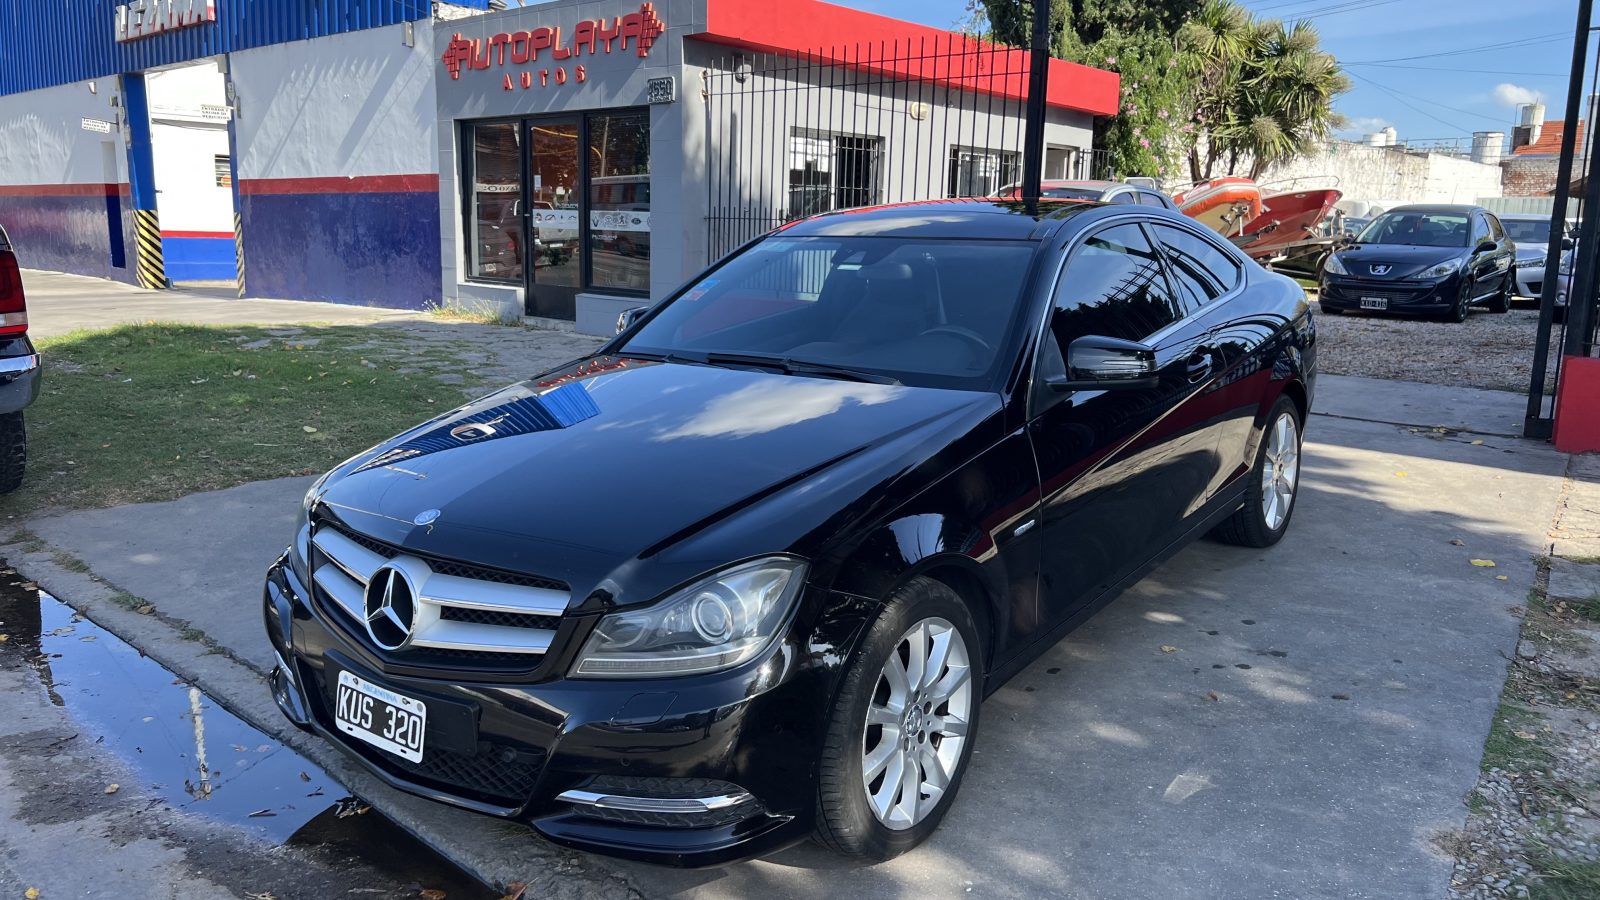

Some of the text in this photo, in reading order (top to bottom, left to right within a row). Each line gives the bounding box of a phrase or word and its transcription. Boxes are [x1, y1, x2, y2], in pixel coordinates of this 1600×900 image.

[114, 0, 214, 42] LEZAMA
[455, 13, 644, 70] AUTOPLAYA
[503, 64, 585, 91] AUTOS
[338, 686, 421, 750] KUS 320
